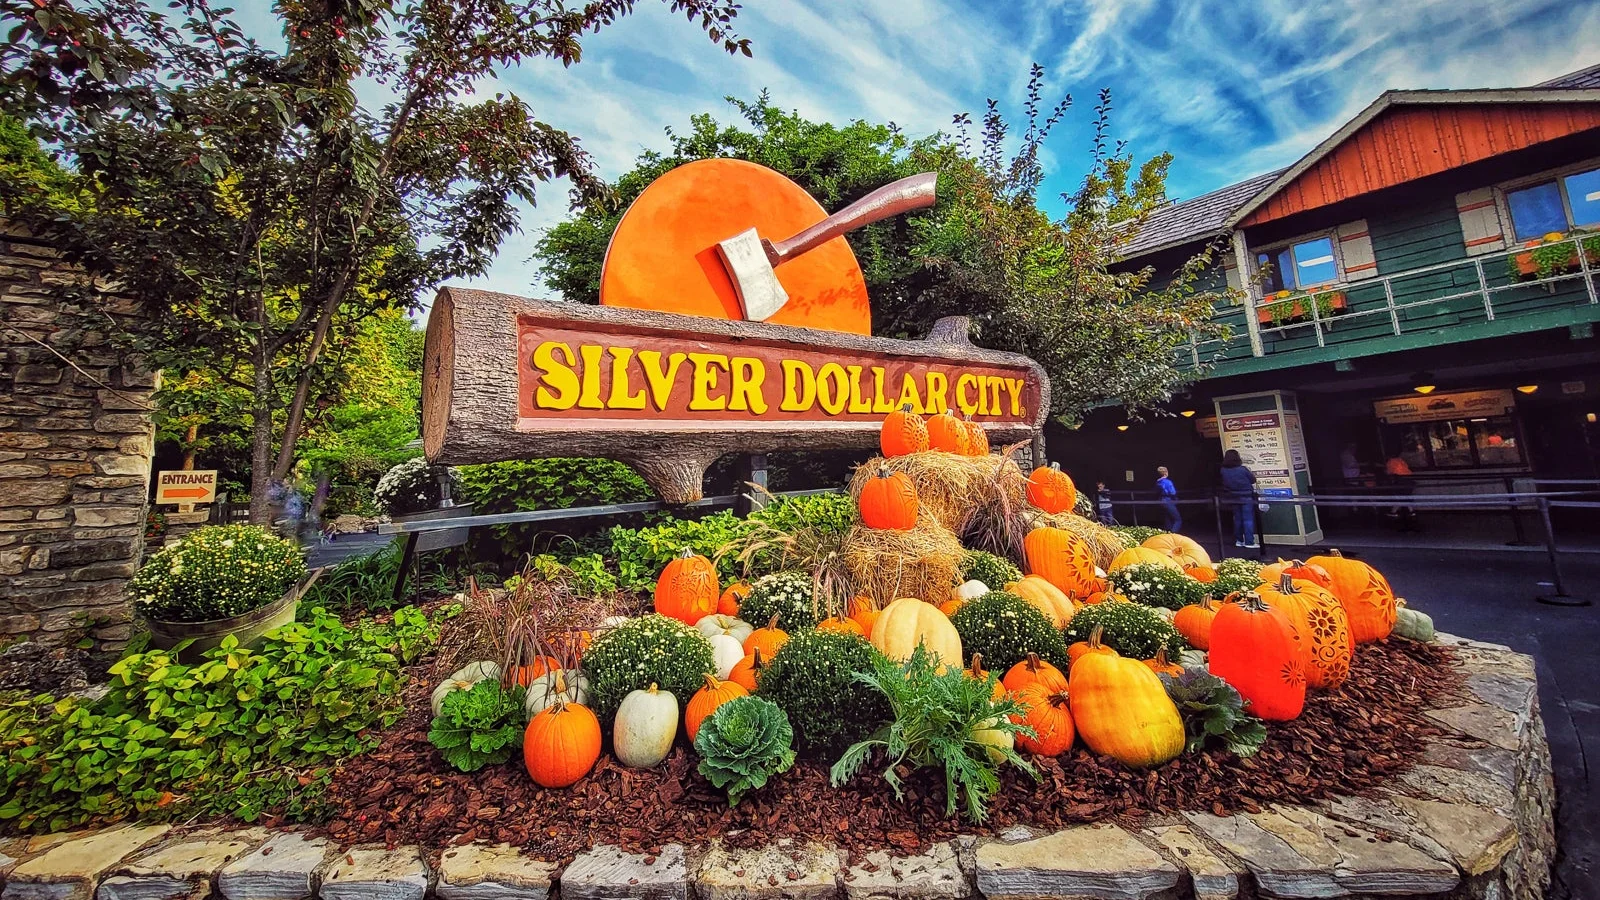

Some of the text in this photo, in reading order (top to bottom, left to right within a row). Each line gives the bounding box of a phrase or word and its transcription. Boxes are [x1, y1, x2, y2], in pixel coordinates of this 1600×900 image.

[533, 341, 769, 415] SILVER
[780, 359, 951, 416] DOLLAR
[162, 474, 213, 484] ENTRANCE
